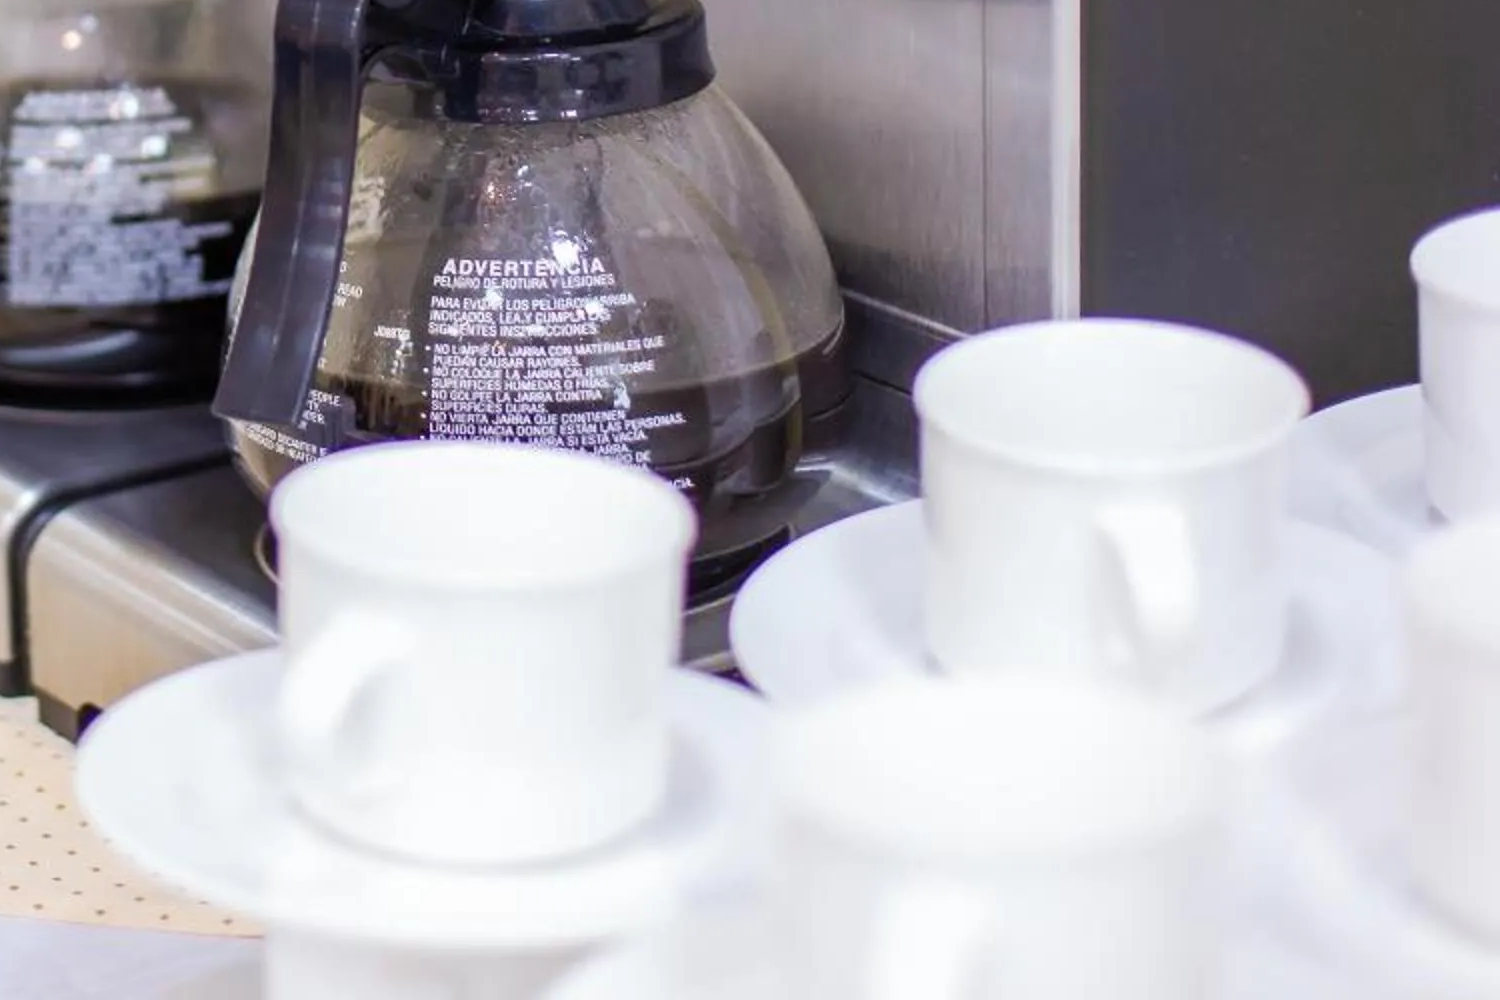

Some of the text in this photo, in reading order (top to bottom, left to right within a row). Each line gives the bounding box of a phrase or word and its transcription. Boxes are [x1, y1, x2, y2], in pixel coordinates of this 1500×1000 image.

[442, 257, 605, 277] ADVERTENCIA
[433, 273, 615, 290] PELIGRO DE ROTURA Y LESIONES
[430, 295, 460, 310] PARA
[505, 299, 530, 311] LOS
[531, 297, 588, 311] PELIGRO
[589, 293, 636, 308] RRIBA
[535, 310, 586, 323] CUMPLA
[434, 343, 450, 355] NO
[508, 345, 546, 358] JARRA
[547, 345, 573, 357] CON
[574, 339, 640, 355] MATERIALES
[642, 335, 664, 349] QUE
[432, 366, 449, 378] NO
[451, 367, 502, 380] COLOQUE
[505, 368, 521, 380] LA
[523, 367, 562, 380] JARRA
[619, 360, 655, 375] SOBRE
[478, 357, 524, 369] CAUSAR
[431, 377, 502, 391] SUPERFICIES
[563, 380, 574, 391] O
[431, 389, 603, 403] NO GOLPEE LA JARRA CONTRA
[431, 400, 503, 415] SUPERFICIES
[430, 409, 626, 426] NO VIERTA JARRA QUE CONTIENEN
[478, 425, 515, 437] HACIA
[599, 419, 622, 434] LAS
[566, 437, 580, 448] SI
